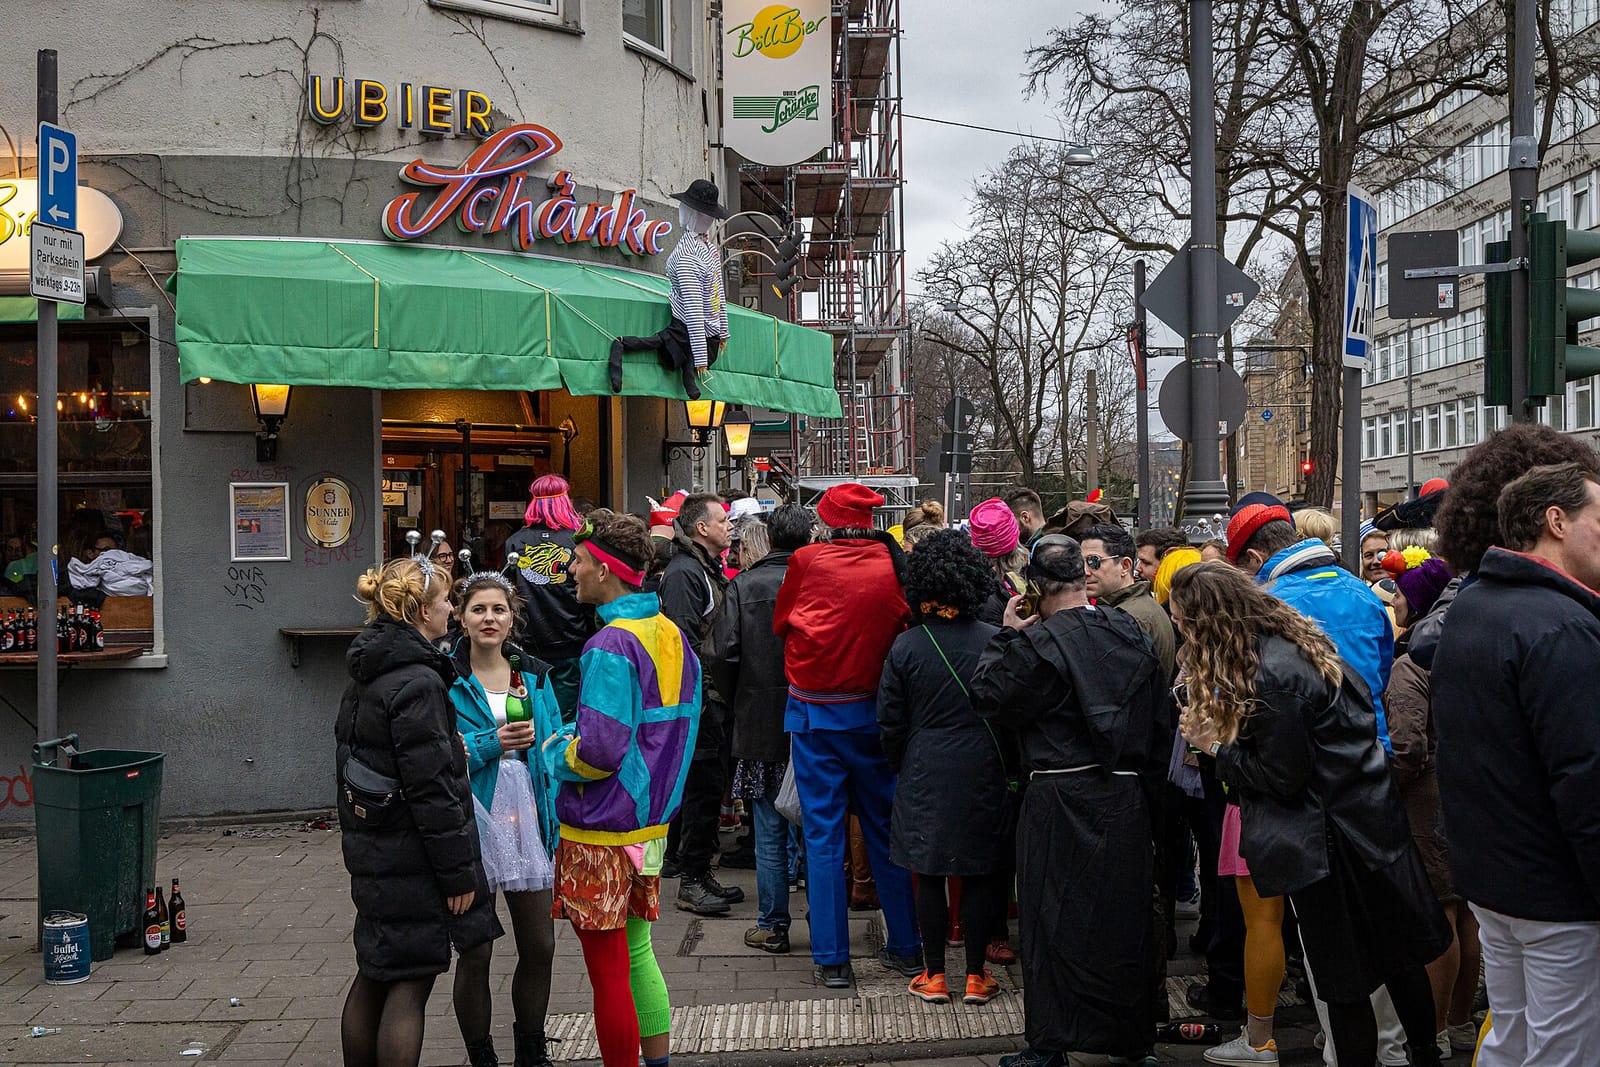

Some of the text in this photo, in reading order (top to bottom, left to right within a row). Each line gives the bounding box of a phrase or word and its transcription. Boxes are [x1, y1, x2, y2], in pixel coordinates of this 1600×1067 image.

[309, 75, 493, 138] UBIER
[48, 136, 70, 196] P
[43, 235, 73, 250] nur mit
[36, 249, 80, 269] Parkschein
[34, 275, 63, 292] werktags
